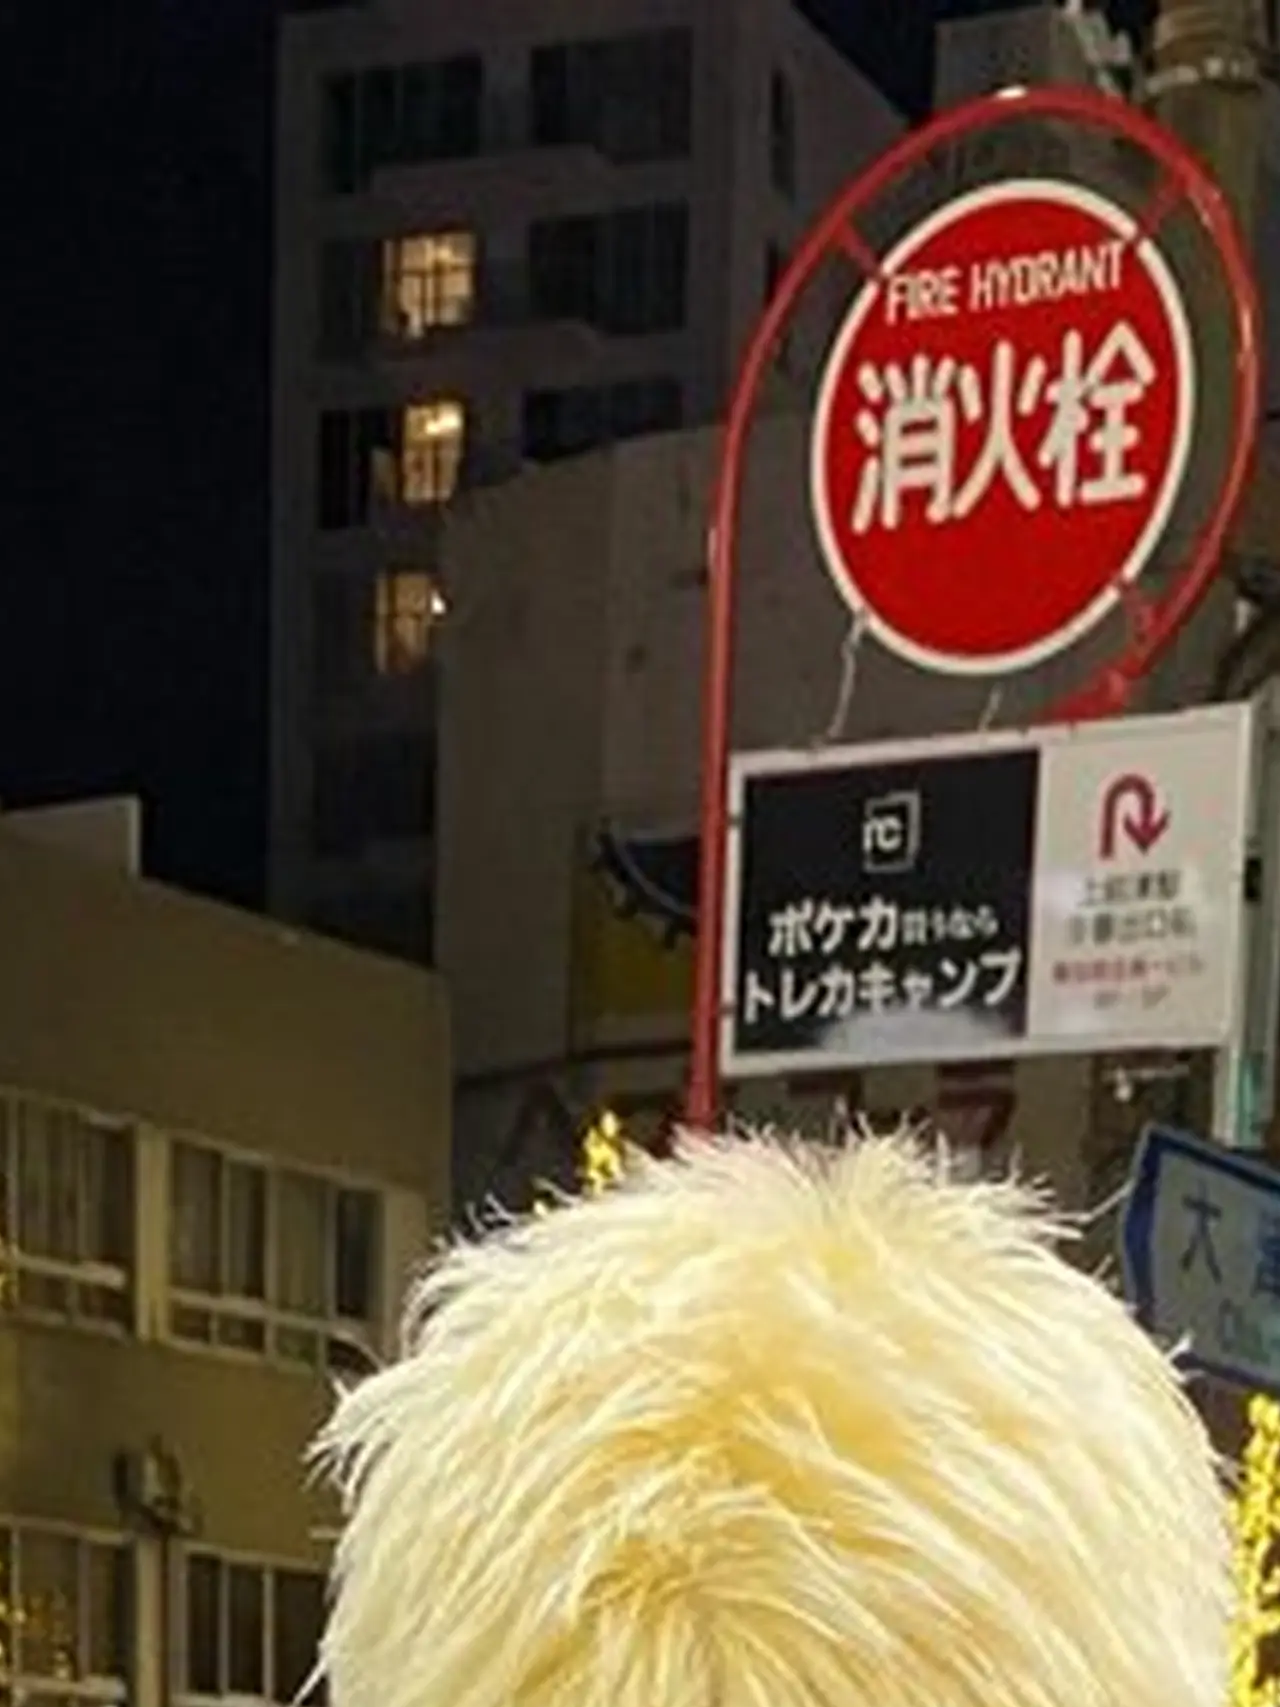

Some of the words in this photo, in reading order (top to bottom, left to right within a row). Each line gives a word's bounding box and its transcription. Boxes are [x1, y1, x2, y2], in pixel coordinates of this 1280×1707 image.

[886, 267, 962, 326] FIRE
[970, 245, 1122, 313] HYDRANT
[852, 321, 1157, 535] 消火栓
[743, 946, 1023, 1025] トレカキャンプ
